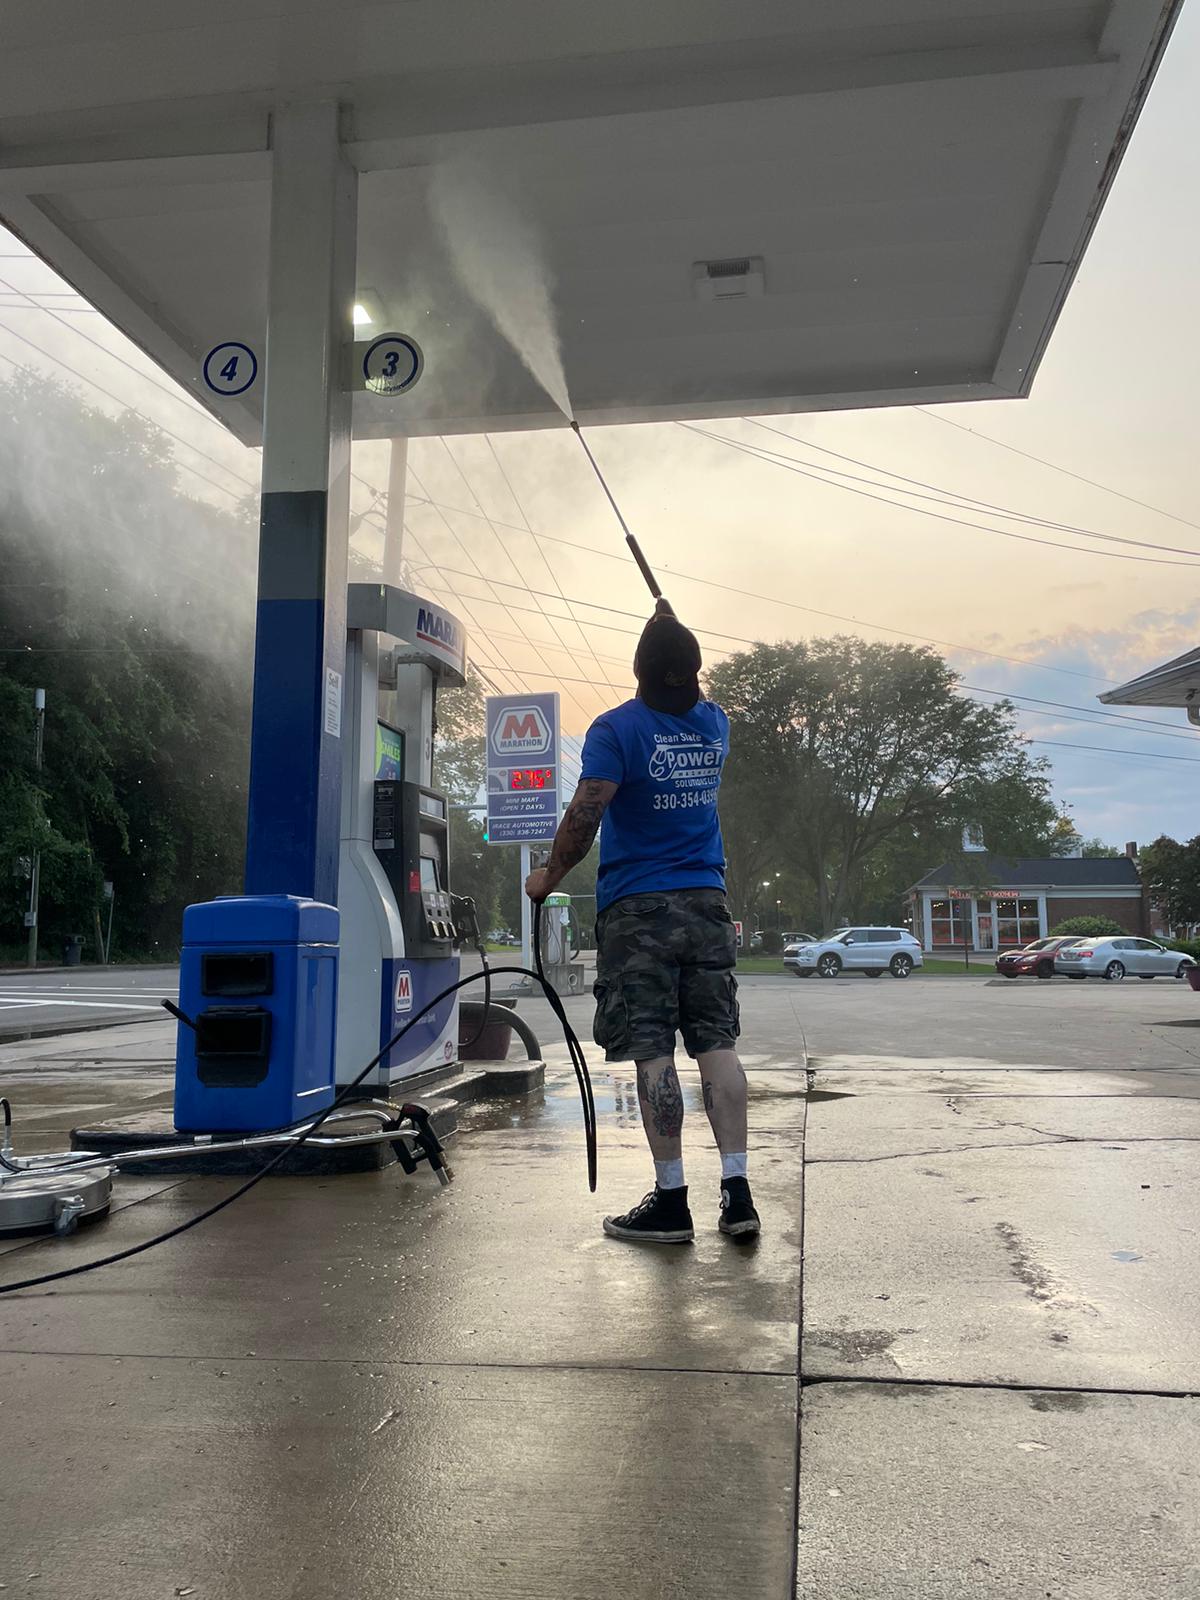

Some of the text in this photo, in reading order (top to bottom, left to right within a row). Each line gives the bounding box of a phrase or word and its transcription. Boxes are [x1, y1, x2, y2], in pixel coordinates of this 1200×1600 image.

[219, 356, 239, 382] 4
[382, 351, 400, 377] 3
[502, 714, 541, 738] M
[500, 739, 542, 748] MARATHON
[654, 732, 702, 743] Clean Slate
[667, 751, 722, 769] Power
[675, 777, 707, 788] SOLUTIONS
[512, 820, 554, 829] AUTOMOTIVE
[398, 977, 410, 997] M
